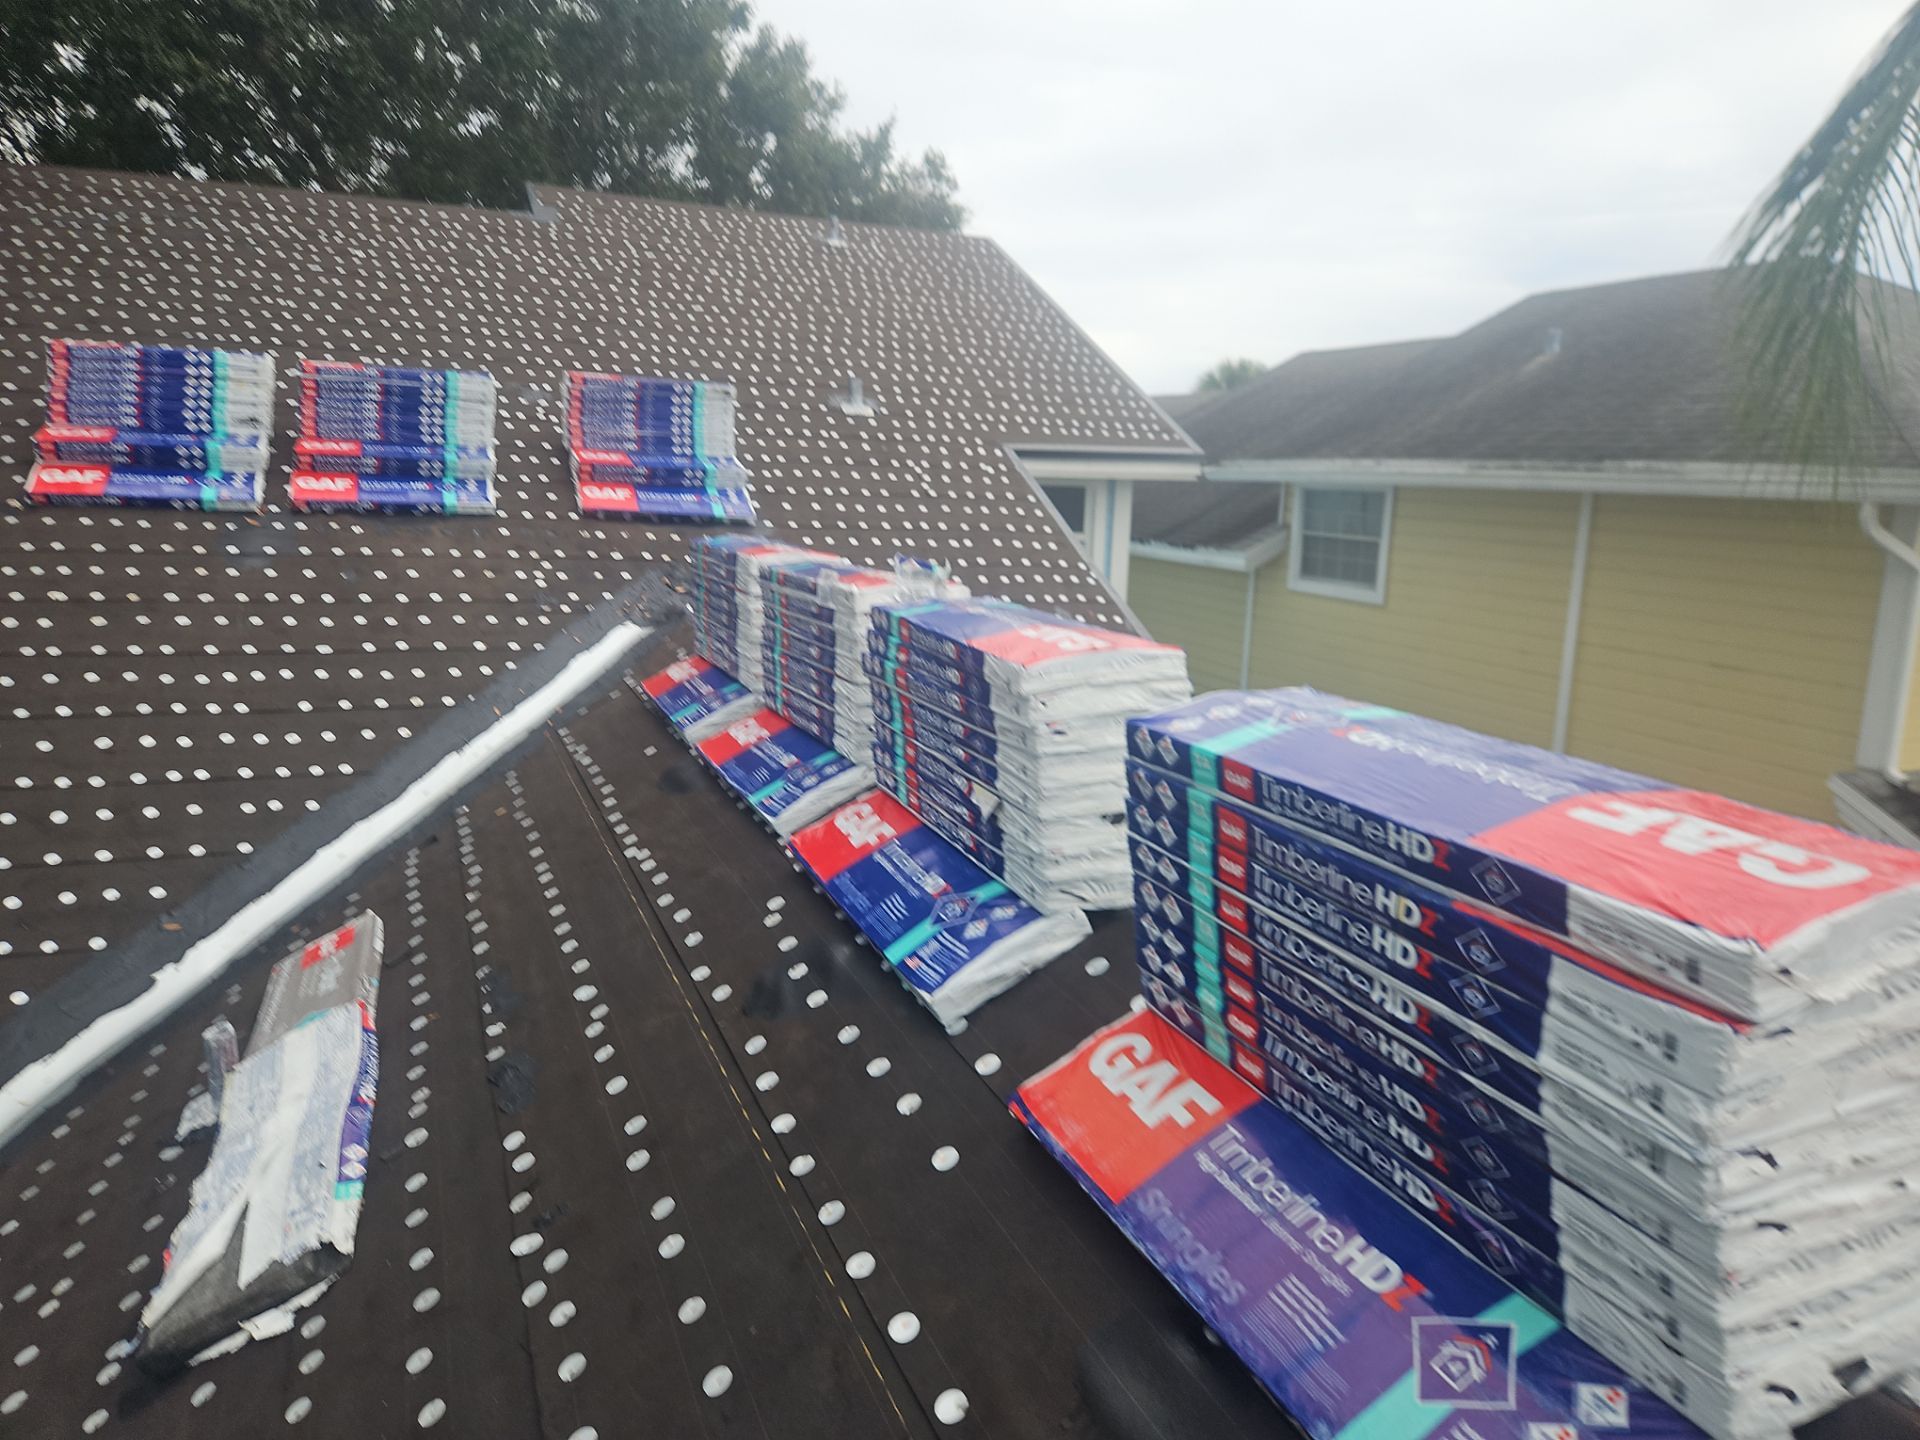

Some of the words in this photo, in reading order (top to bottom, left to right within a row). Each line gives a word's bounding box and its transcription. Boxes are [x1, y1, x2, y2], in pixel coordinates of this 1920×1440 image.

[295, 476, 354, 492] GAF
[1566, 800, 1872, 888] GAF
[1088, 1032, 1225, 1130] GAF
[1135, 1187, 1247, 1306] Shingles
